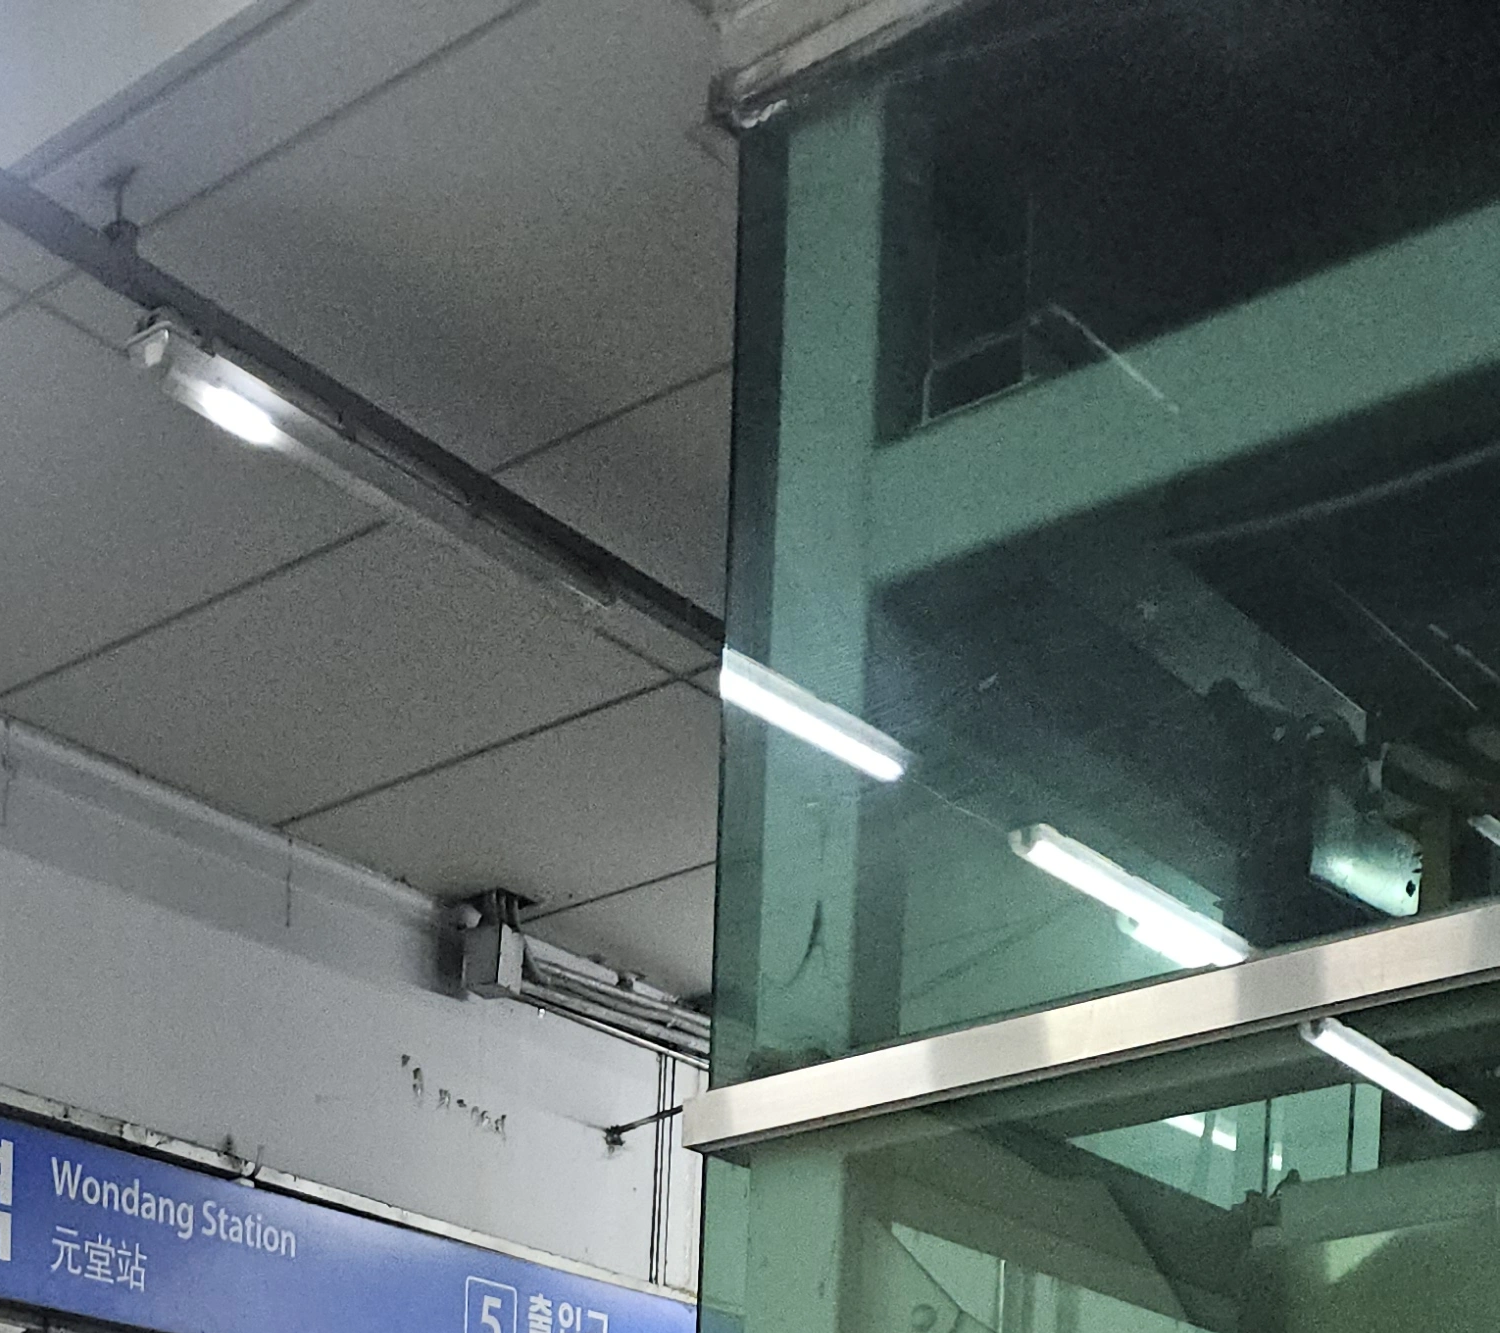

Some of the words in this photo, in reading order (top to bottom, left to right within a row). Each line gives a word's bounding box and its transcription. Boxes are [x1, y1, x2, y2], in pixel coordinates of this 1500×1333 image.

[50, 1155, 194, 1240] Wondang
[201, 1207, 298, 1260] Station
[50, 1225, 149, 1293] 元堂站
